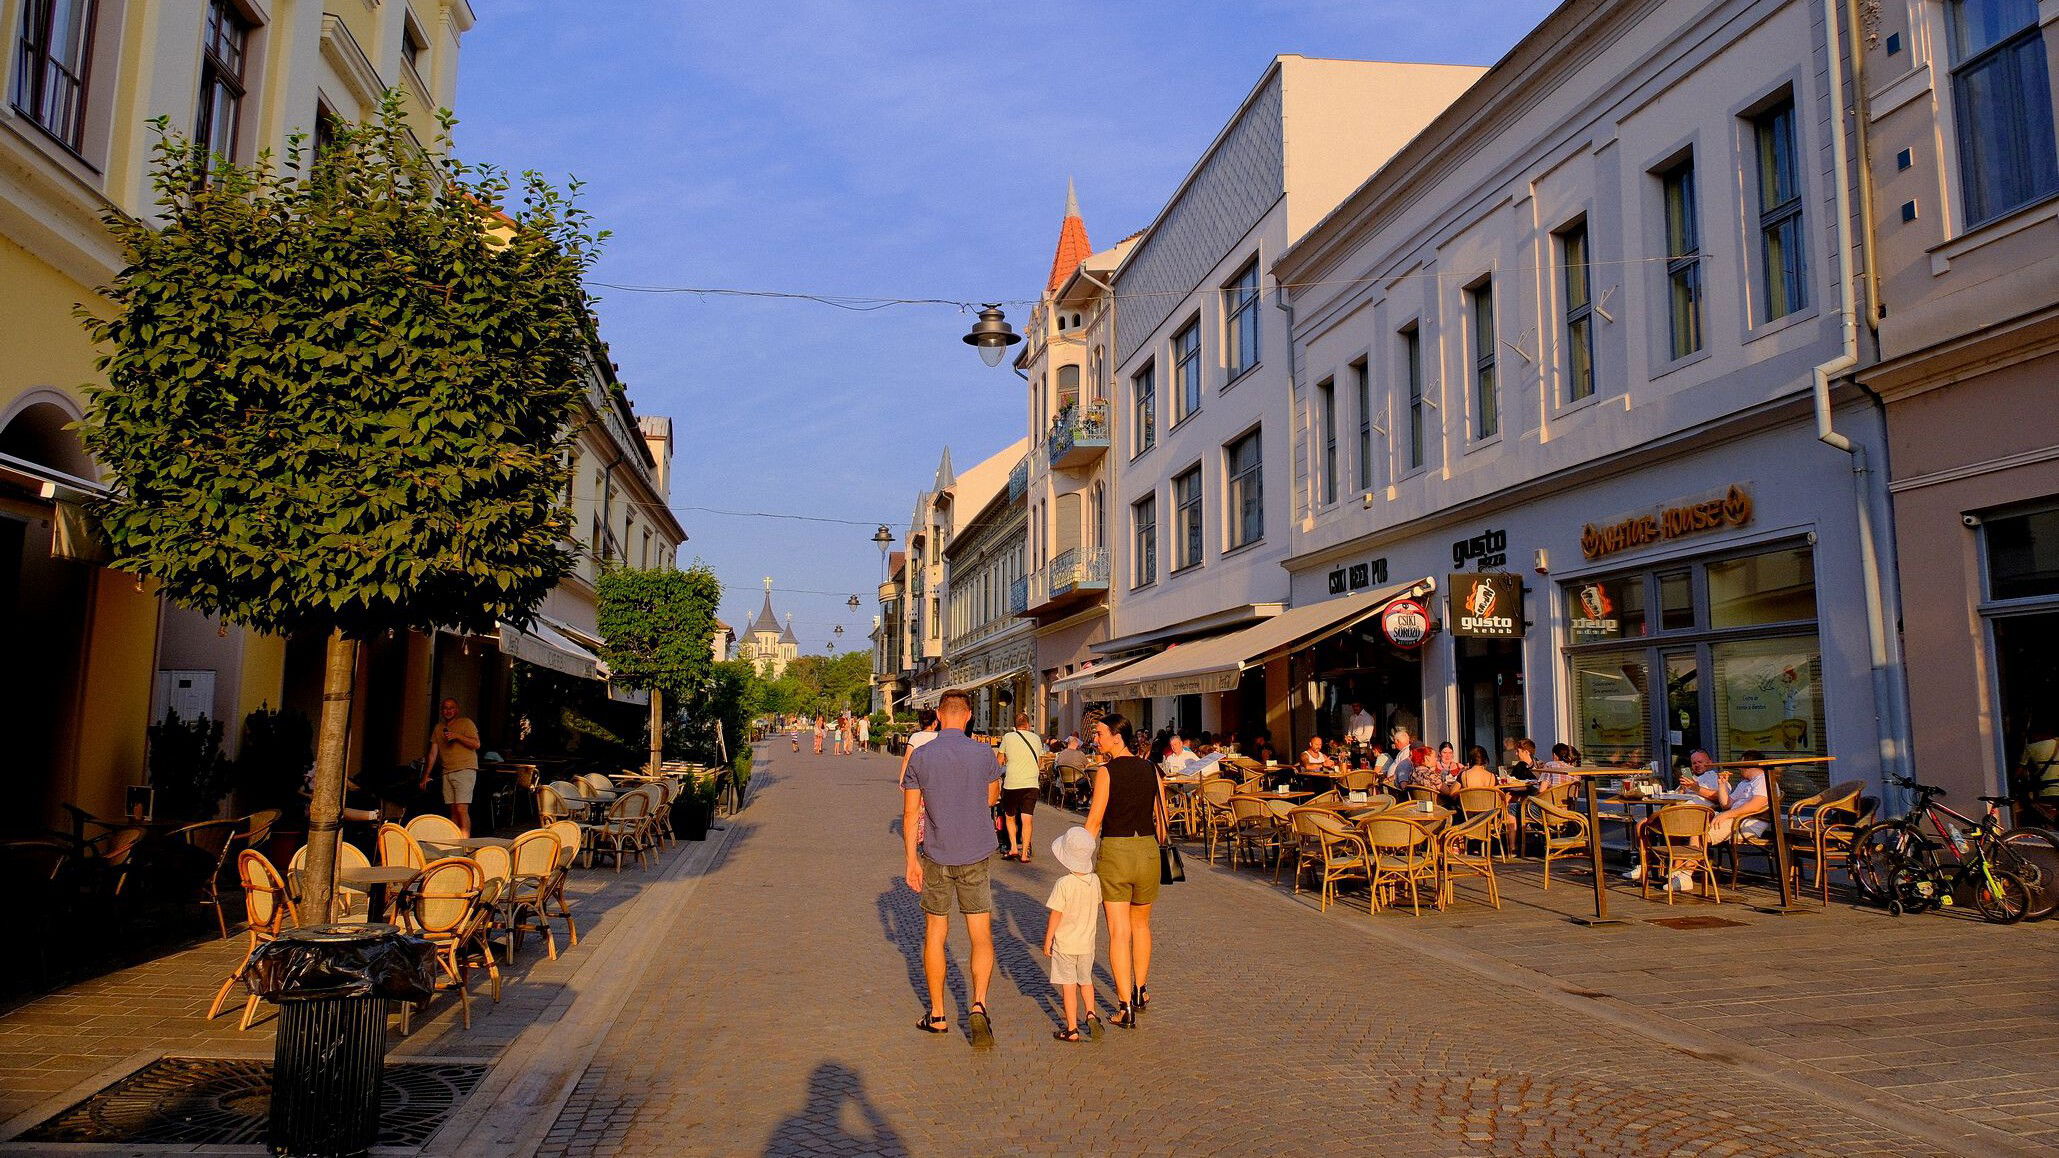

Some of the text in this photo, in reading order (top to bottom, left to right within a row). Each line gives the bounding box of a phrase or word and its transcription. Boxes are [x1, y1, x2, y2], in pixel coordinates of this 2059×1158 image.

[1600, 497, 1726, 554] NATUR HOUSE
[1453, 529, 1506, 569] gusto
[1329, 557, 1388, 595] CSÍKI BEER PUB
[1461, 616, 1512, 630] gusto
